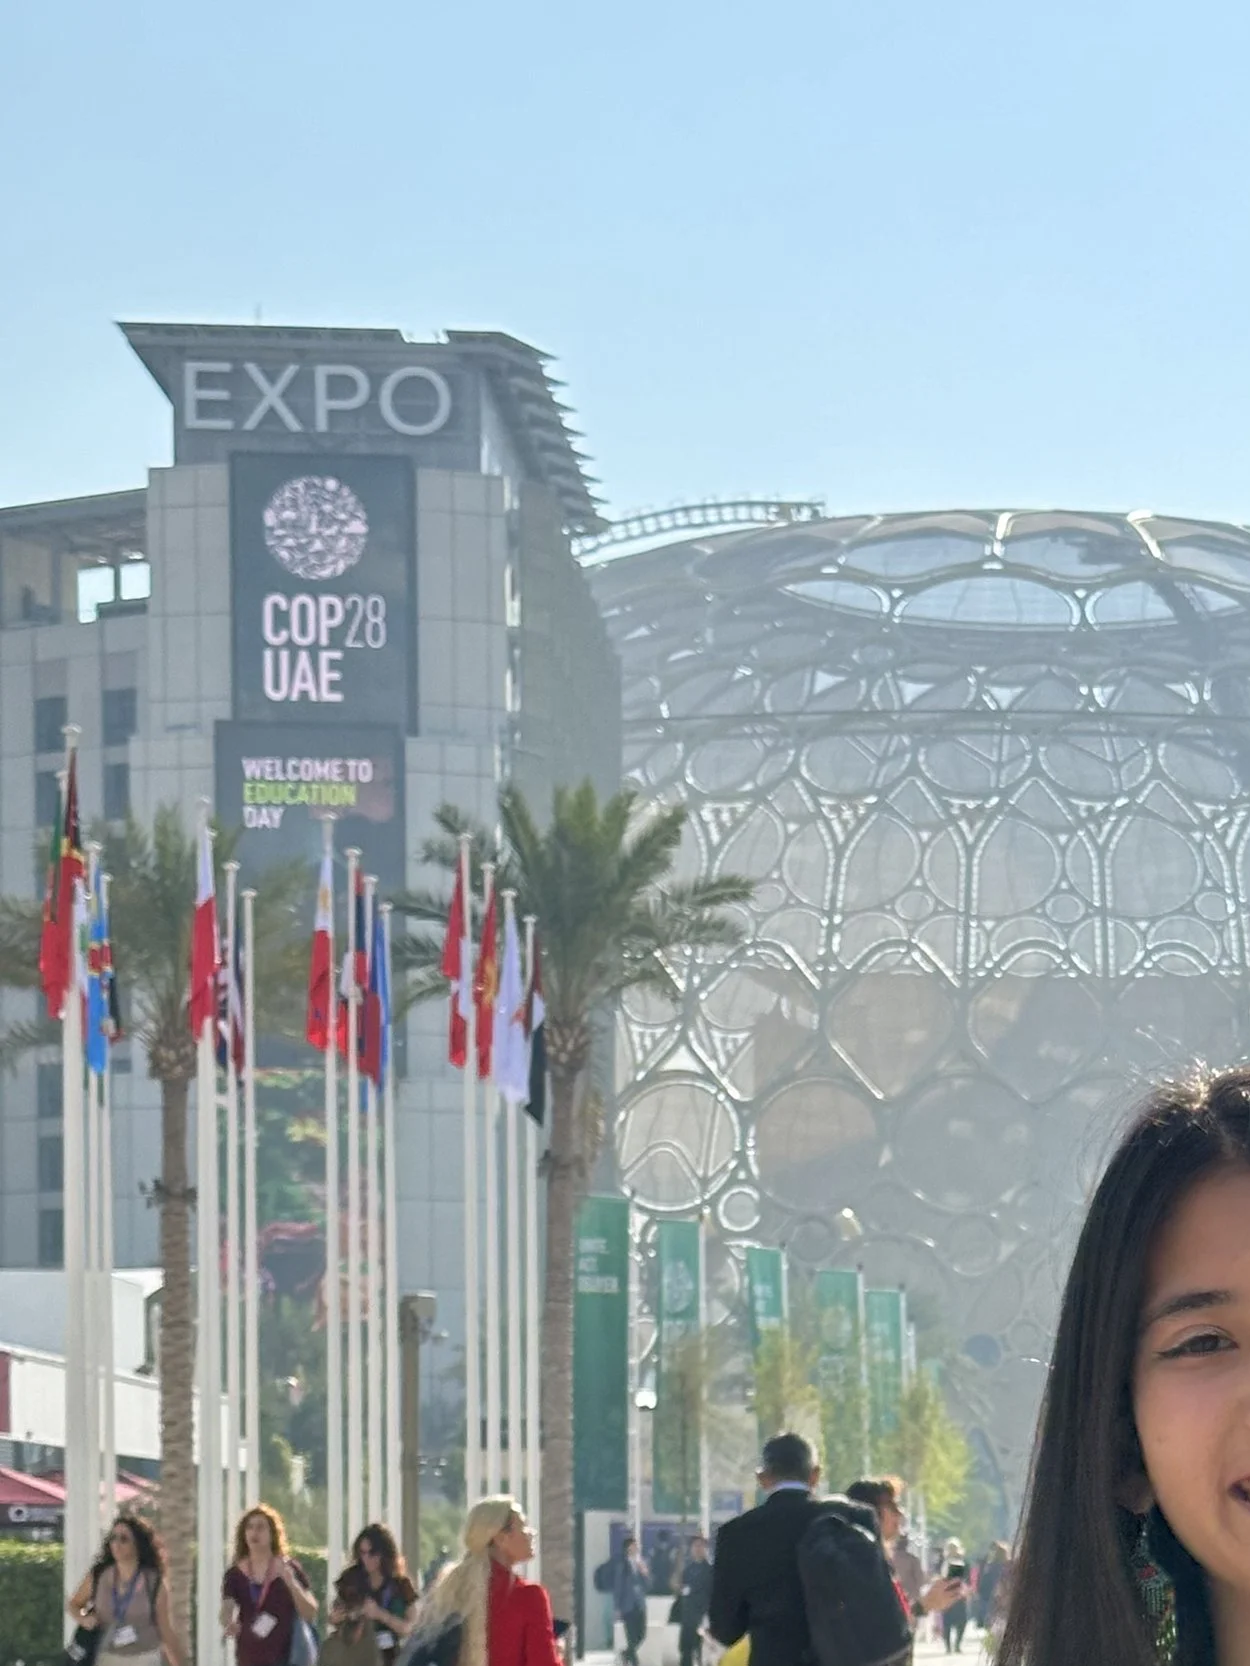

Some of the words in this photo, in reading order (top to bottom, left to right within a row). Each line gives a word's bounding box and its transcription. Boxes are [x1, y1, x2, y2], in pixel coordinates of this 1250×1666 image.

[183, 361, 452, 436] EXPO
[263, 592, 387, 649] COP28
[263, 648, 345, 702] UAE
[241, 757, 345, 783] WELCOME
[346, 758, 374, 783] TO
[242, 781, 357, 806] EDUCATION
[242, 805, 285, 829] DAY
